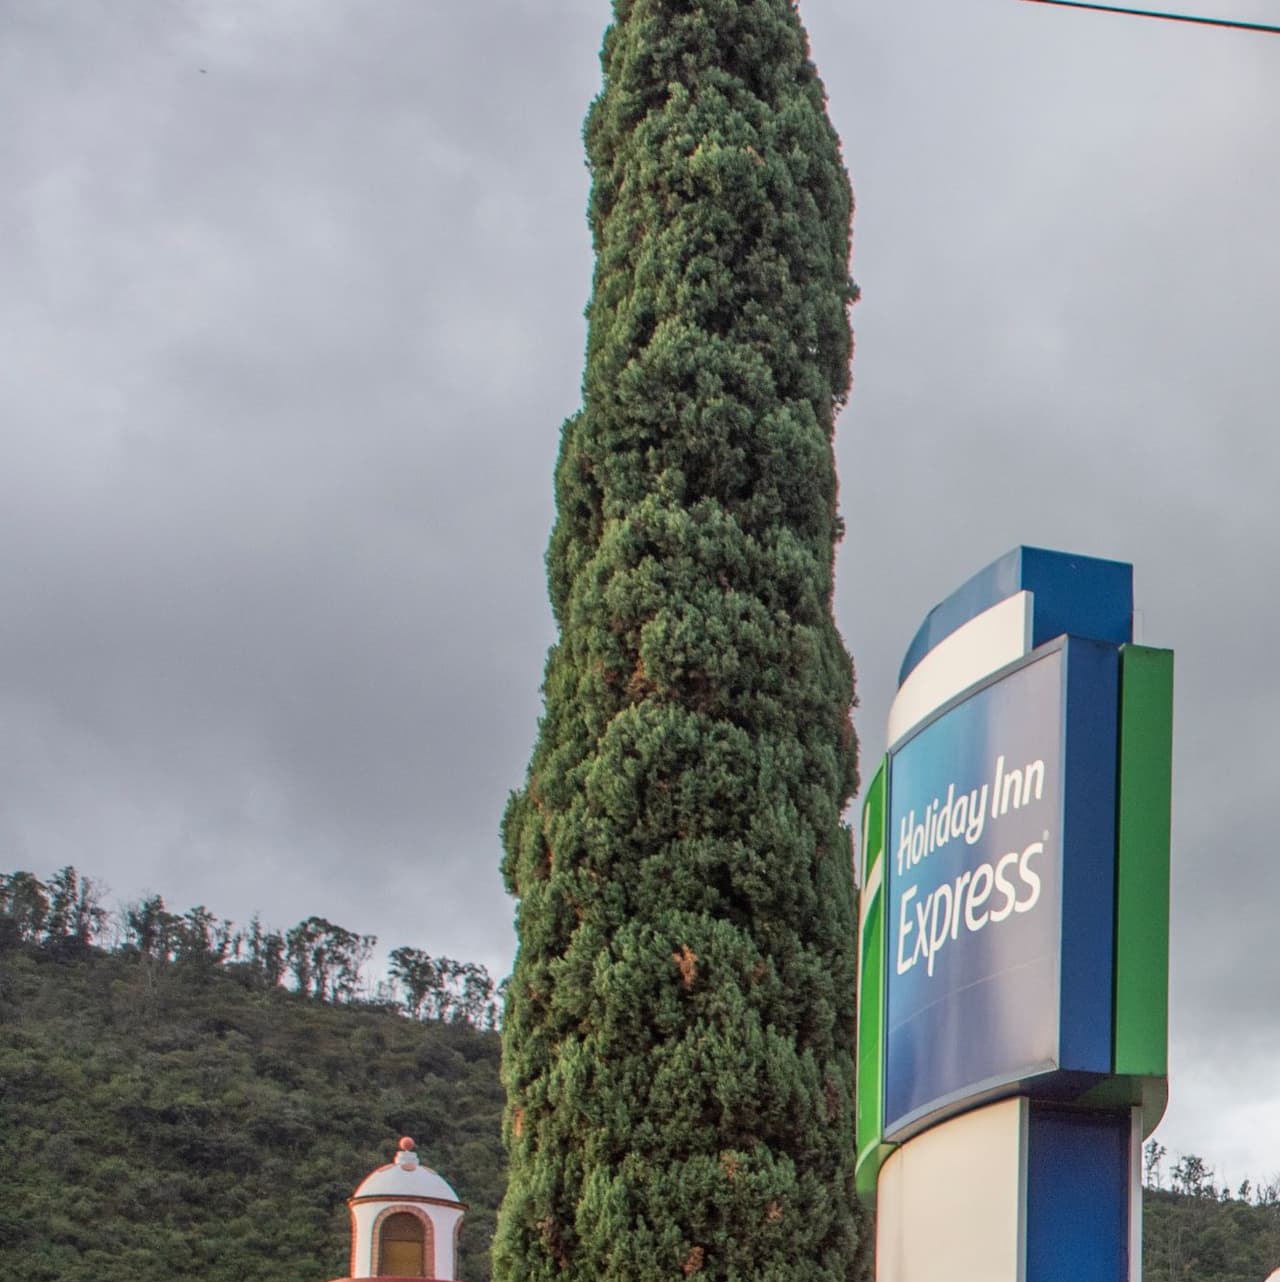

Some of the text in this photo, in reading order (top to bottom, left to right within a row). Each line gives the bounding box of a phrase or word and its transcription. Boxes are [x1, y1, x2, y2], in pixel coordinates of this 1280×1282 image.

[897, 755, 1045, 876] Holiday Inn
[897, 842, 1043, 977] Express
